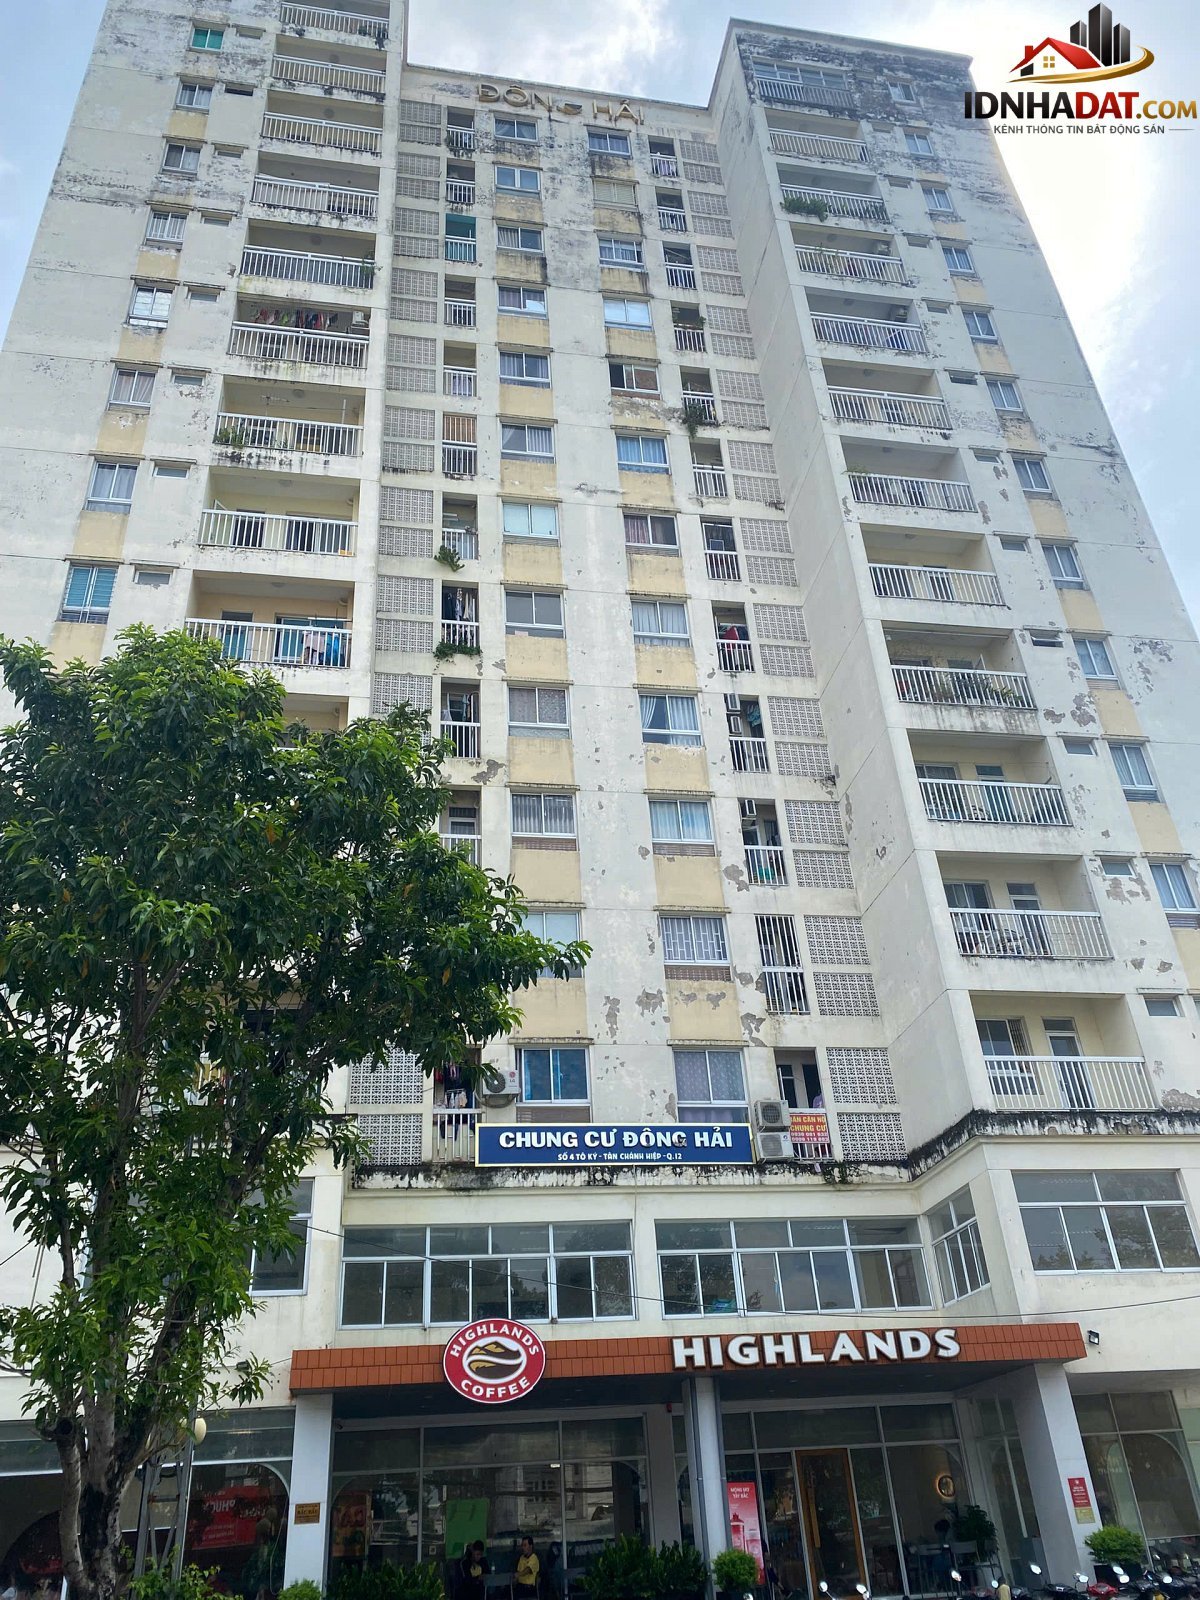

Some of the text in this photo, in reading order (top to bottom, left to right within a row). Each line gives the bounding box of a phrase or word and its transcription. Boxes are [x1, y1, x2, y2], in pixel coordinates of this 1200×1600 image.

[499, 1126, 733, 1148] CHUNG CƯ ĐÔNG HẢI
[557, 1151, 568, 1160] SỐ
[587, 1152, 598, 1160] KÝ
[603, 1152, 618, 1160] TÂN
[619, 1151, 644, 1160] CHÁNH
[645, 1151, 661, 1161] HIỆP
[450, 1322, 539, 1358] HIGHLANDS
[672, 1329, 961, 1369] HIGHLANDS
[460, 1375, 530, 1399] COFFEE
